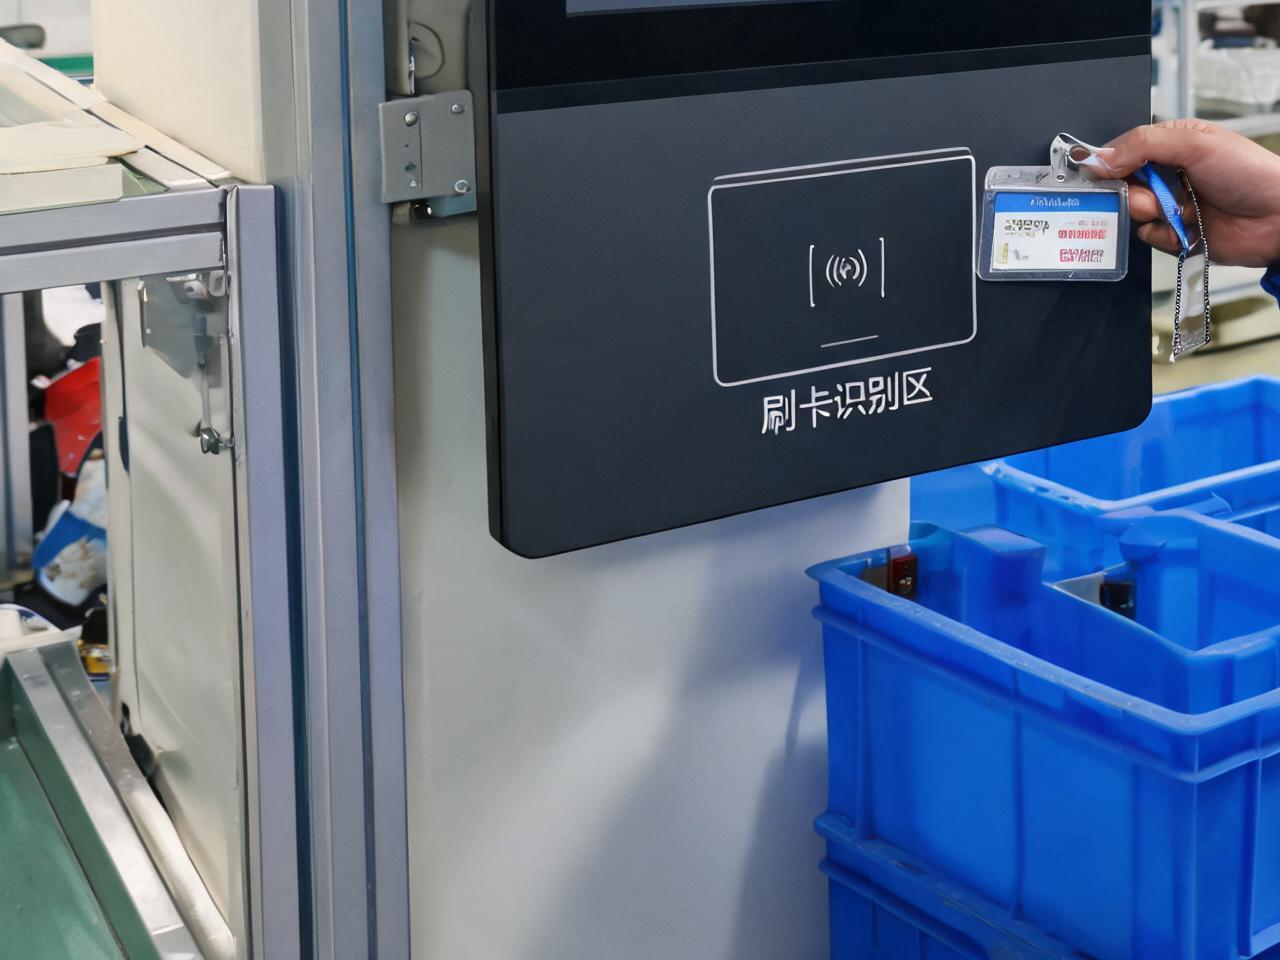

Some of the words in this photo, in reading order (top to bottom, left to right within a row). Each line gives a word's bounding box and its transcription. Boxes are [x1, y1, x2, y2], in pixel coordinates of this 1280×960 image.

[760, 367, 933, 435] 刷卡识别区
